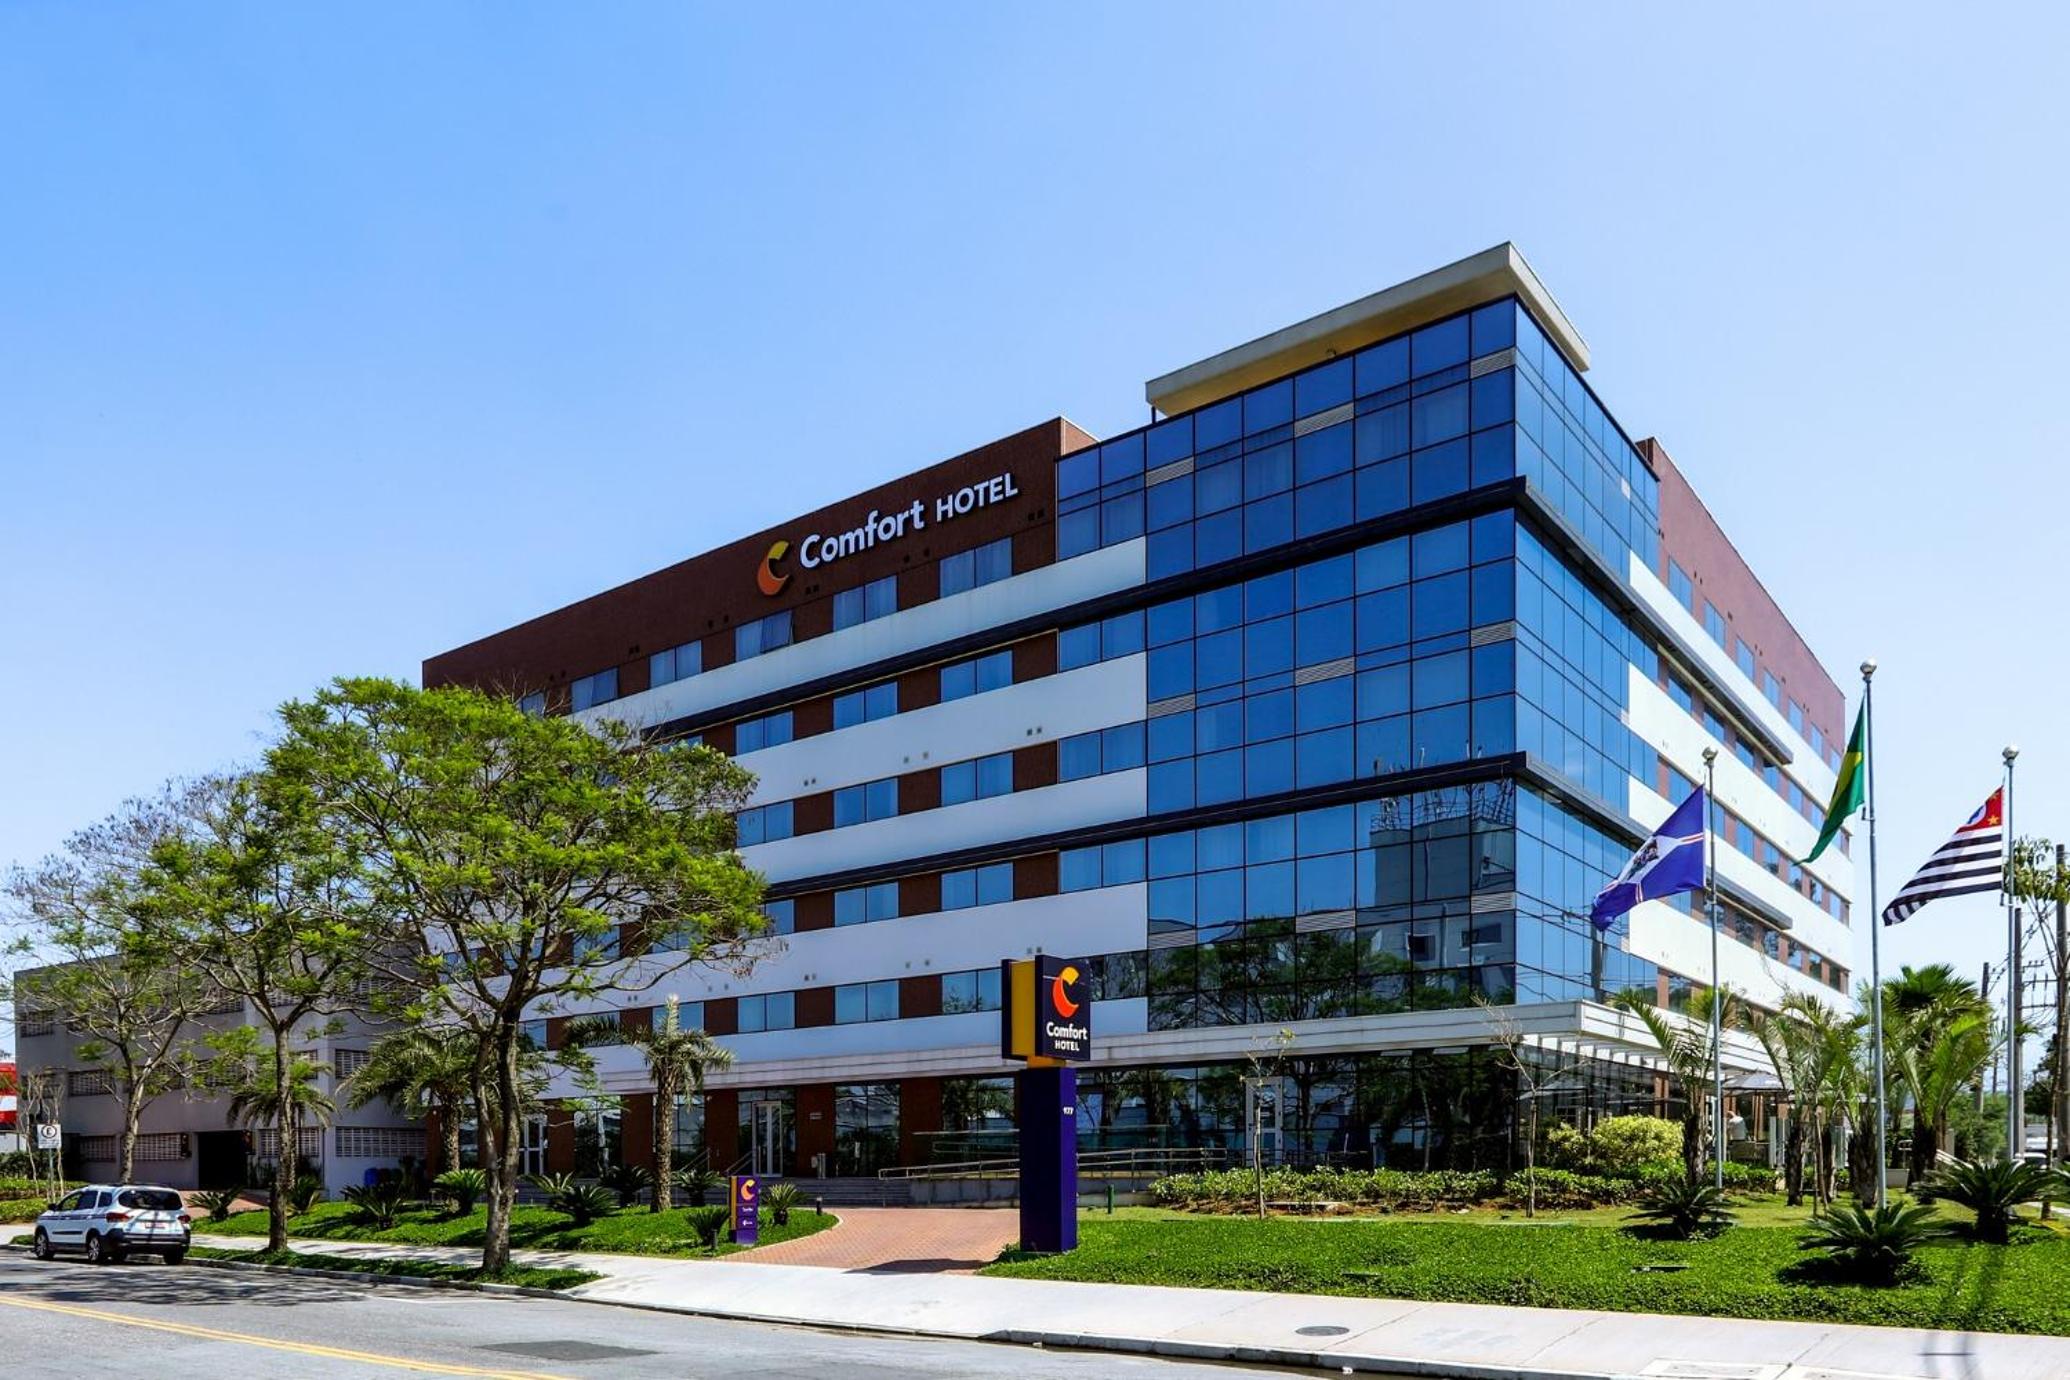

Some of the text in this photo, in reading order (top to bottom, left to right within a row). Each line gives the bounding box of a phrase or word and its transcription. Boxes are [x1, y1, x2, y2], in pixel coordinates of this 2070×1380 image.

[800, 472, 1018, 569] Comfort HOTEL
[1046, 1021, 1088, 1040] Comfort
[1055, 1040, 1080, 1051] HOTEL
